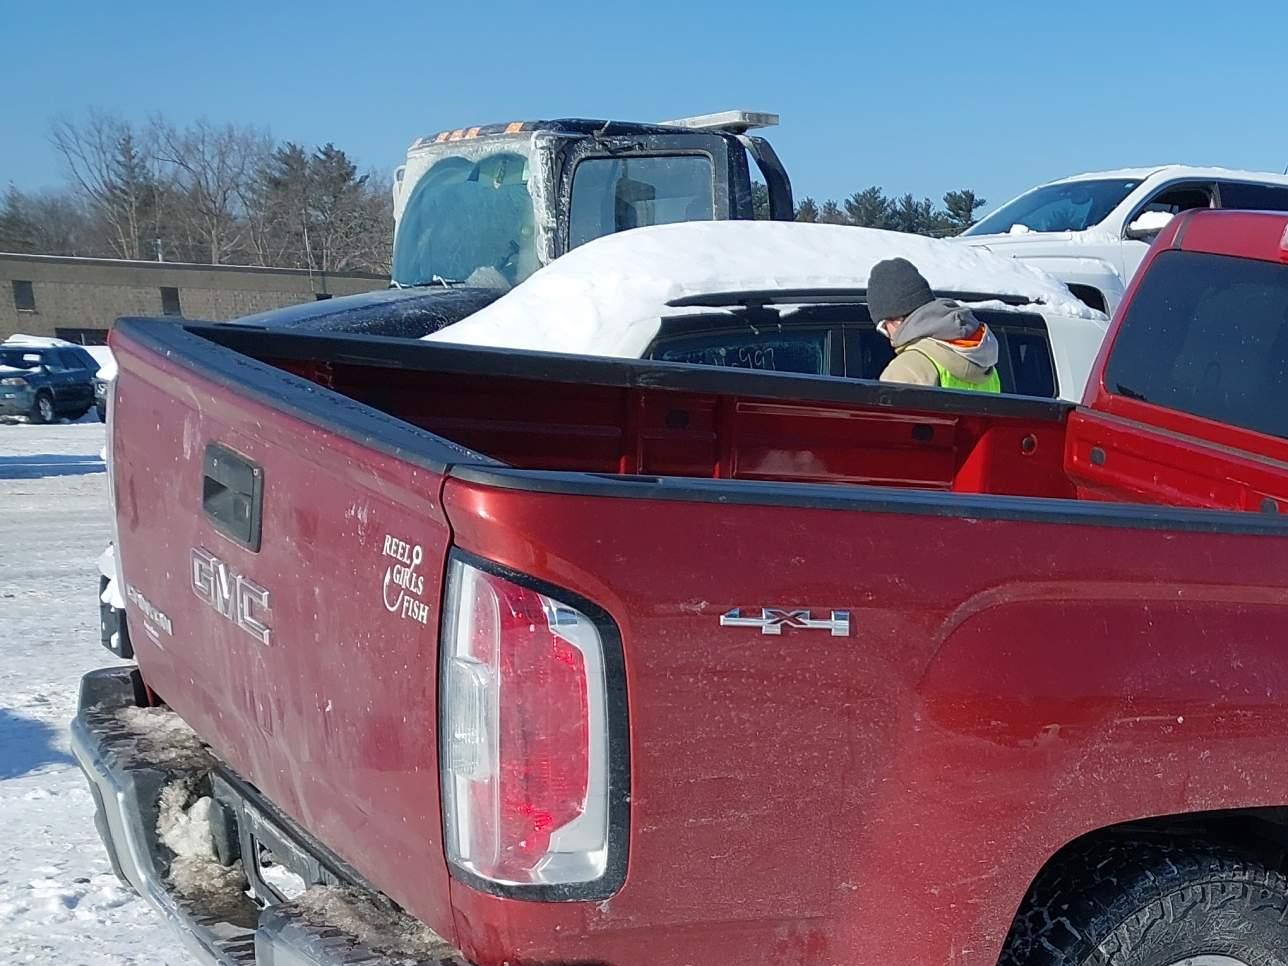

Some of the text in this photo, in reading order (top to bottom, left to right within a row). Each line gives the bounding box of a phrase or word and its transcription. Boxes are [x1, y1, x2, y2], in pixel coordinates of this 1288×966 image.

[382, 534, 411, 565] REEL
[392, 563, 424, 596] GIRLS
[191, 547, 273, 646] GMC
[401, 595, 429, 625] FISH
